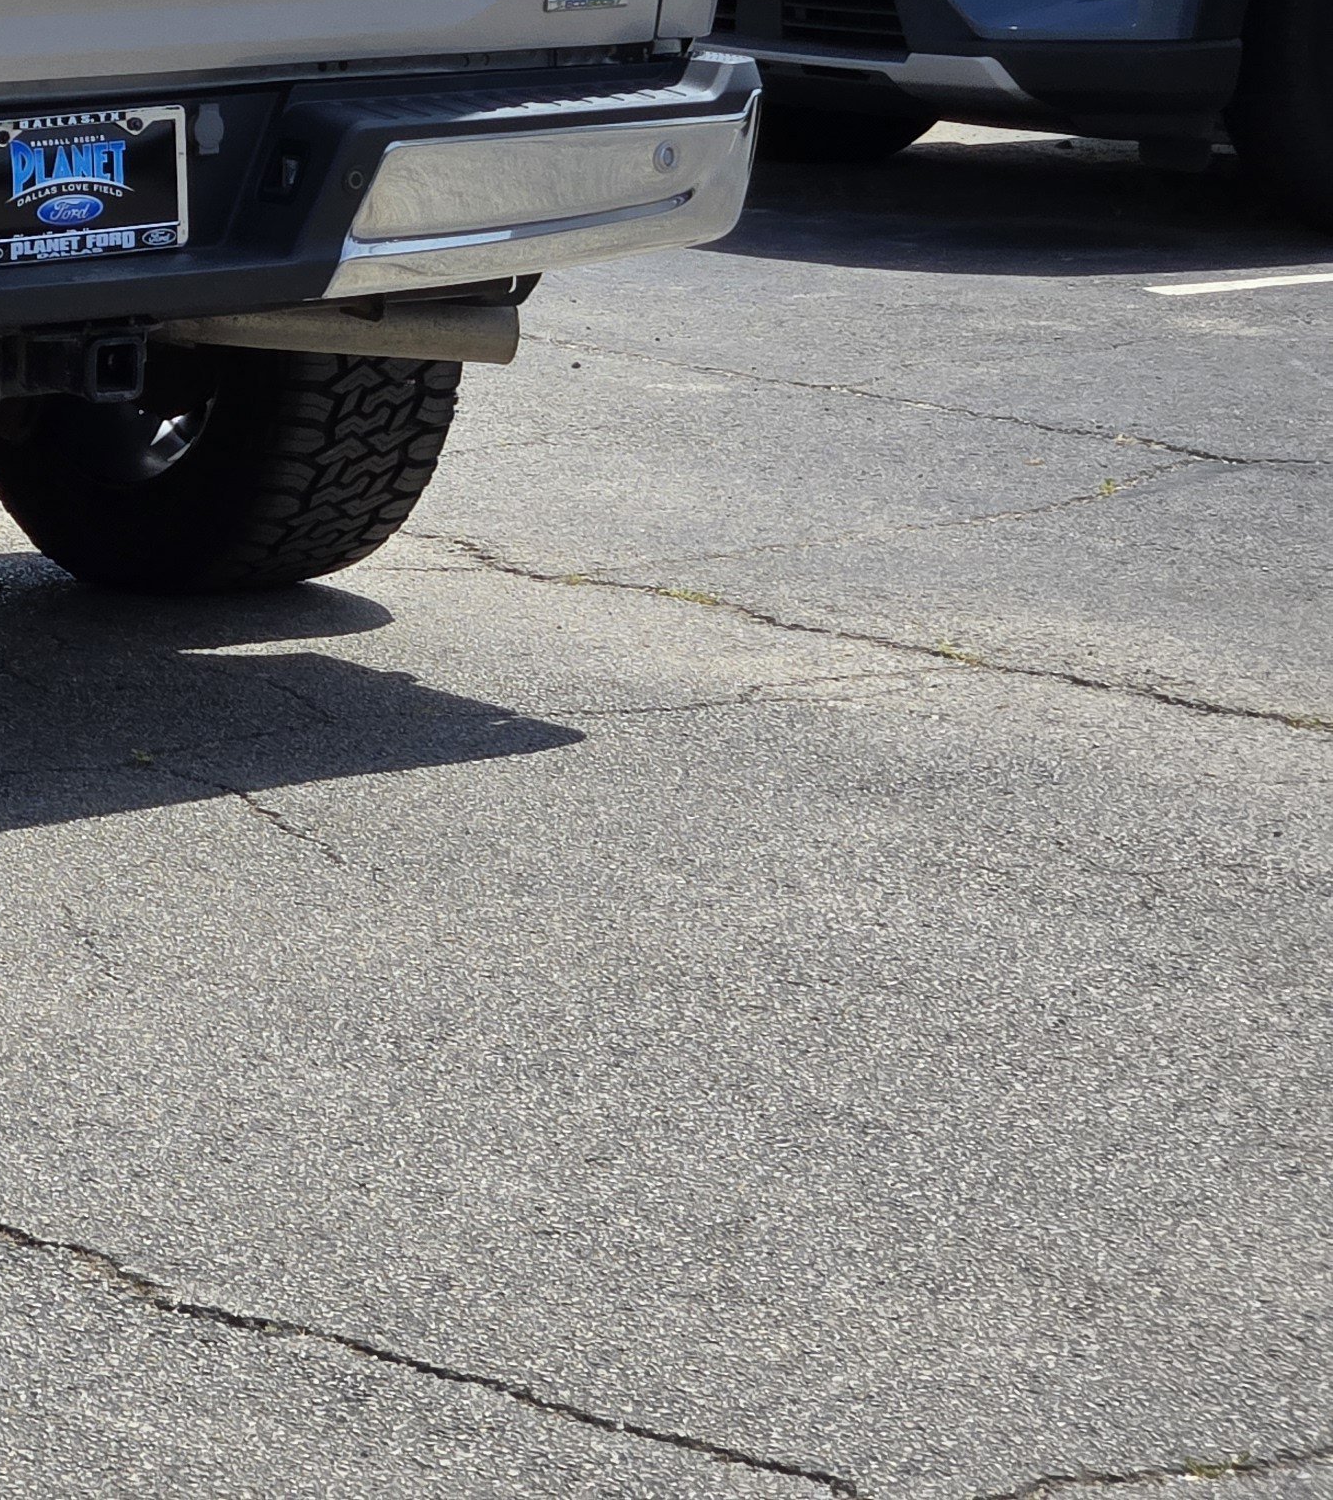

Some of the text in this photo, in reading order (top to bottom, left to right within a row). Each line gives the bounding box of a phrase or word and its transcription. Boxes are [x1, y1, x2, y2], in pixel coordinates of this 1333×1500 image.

[97, 111, 120, 122] TX
[10, 139, 126, 197] PLANET
[16, 183, 124, 208] DALLAS LOVE FIELD
[49, 200, 92, 221] Ford
[10, 237, 81, 261] PLANET
[85, 231, 136, 249] FORD
